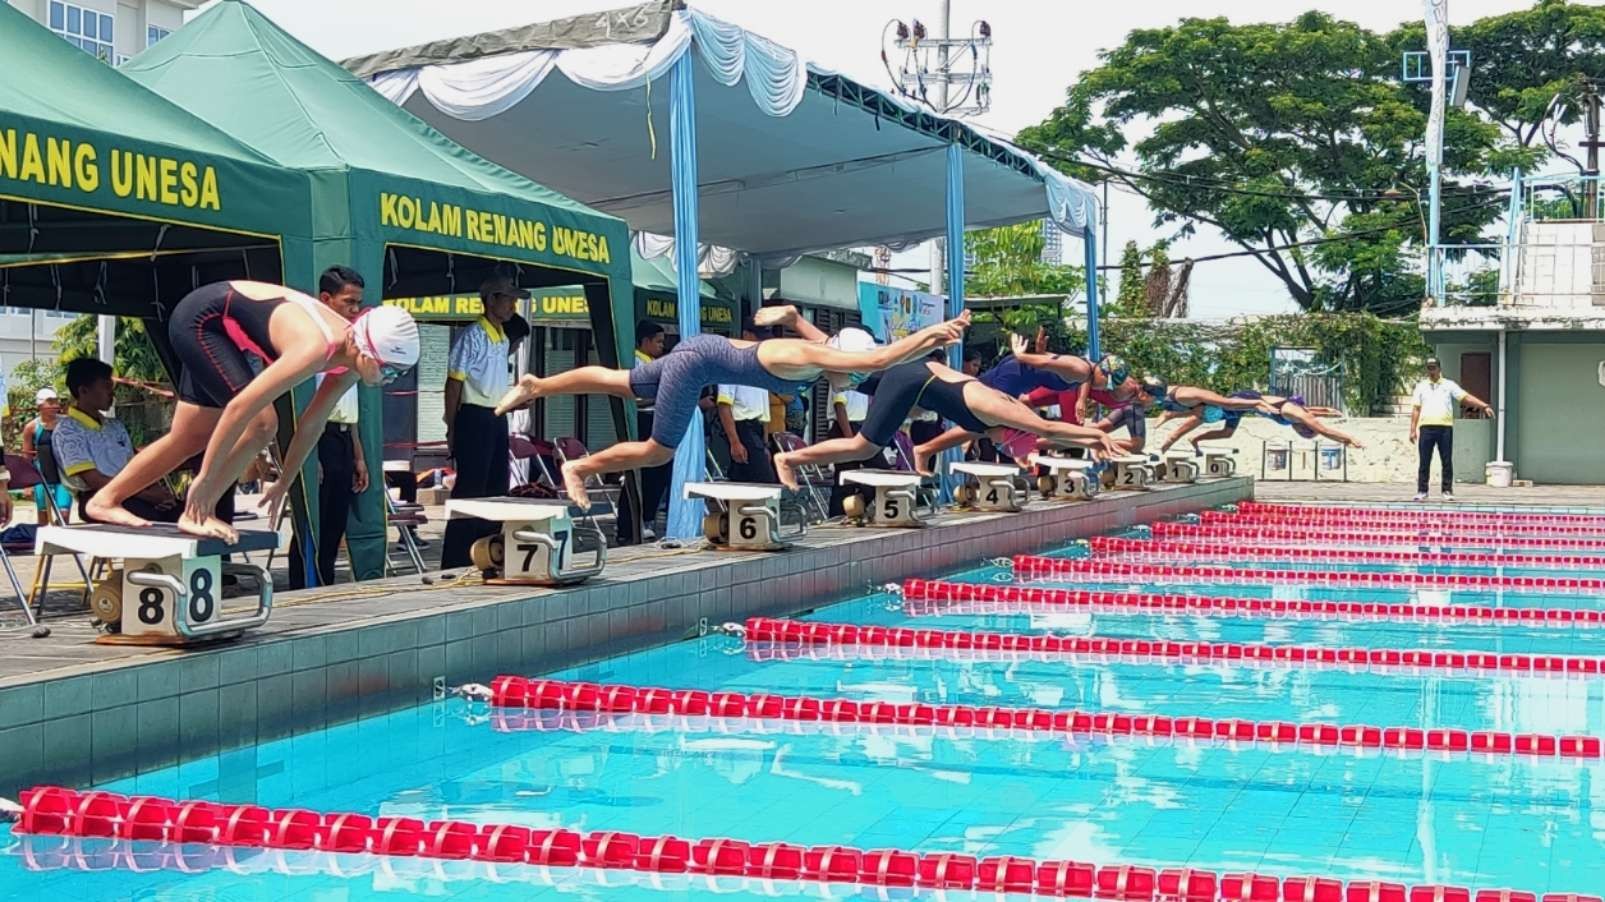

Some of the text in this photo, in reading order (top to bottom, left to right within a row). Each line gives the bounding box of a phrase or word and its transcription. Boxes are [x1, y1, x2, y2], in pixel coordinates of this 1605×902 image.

[111, 149, 221, 211] UNESA
[380, 192, 611, 264] KOLAM RENANG UNESA
[1124, 472, 1134, 485] 2
[1172, 467, 1179, 478] 1
[986, 488, 999, 504] 4
[1064, 479, 1075, 493] 3
[884, 500, 899, 519] 5
[739, 517, 757, 539] 6
[517, 544, 539, 572] 7
[554, 530, 568, 570] 7
[138, 587, 165, 625] 8
[189, 568, 214, 622] 8
